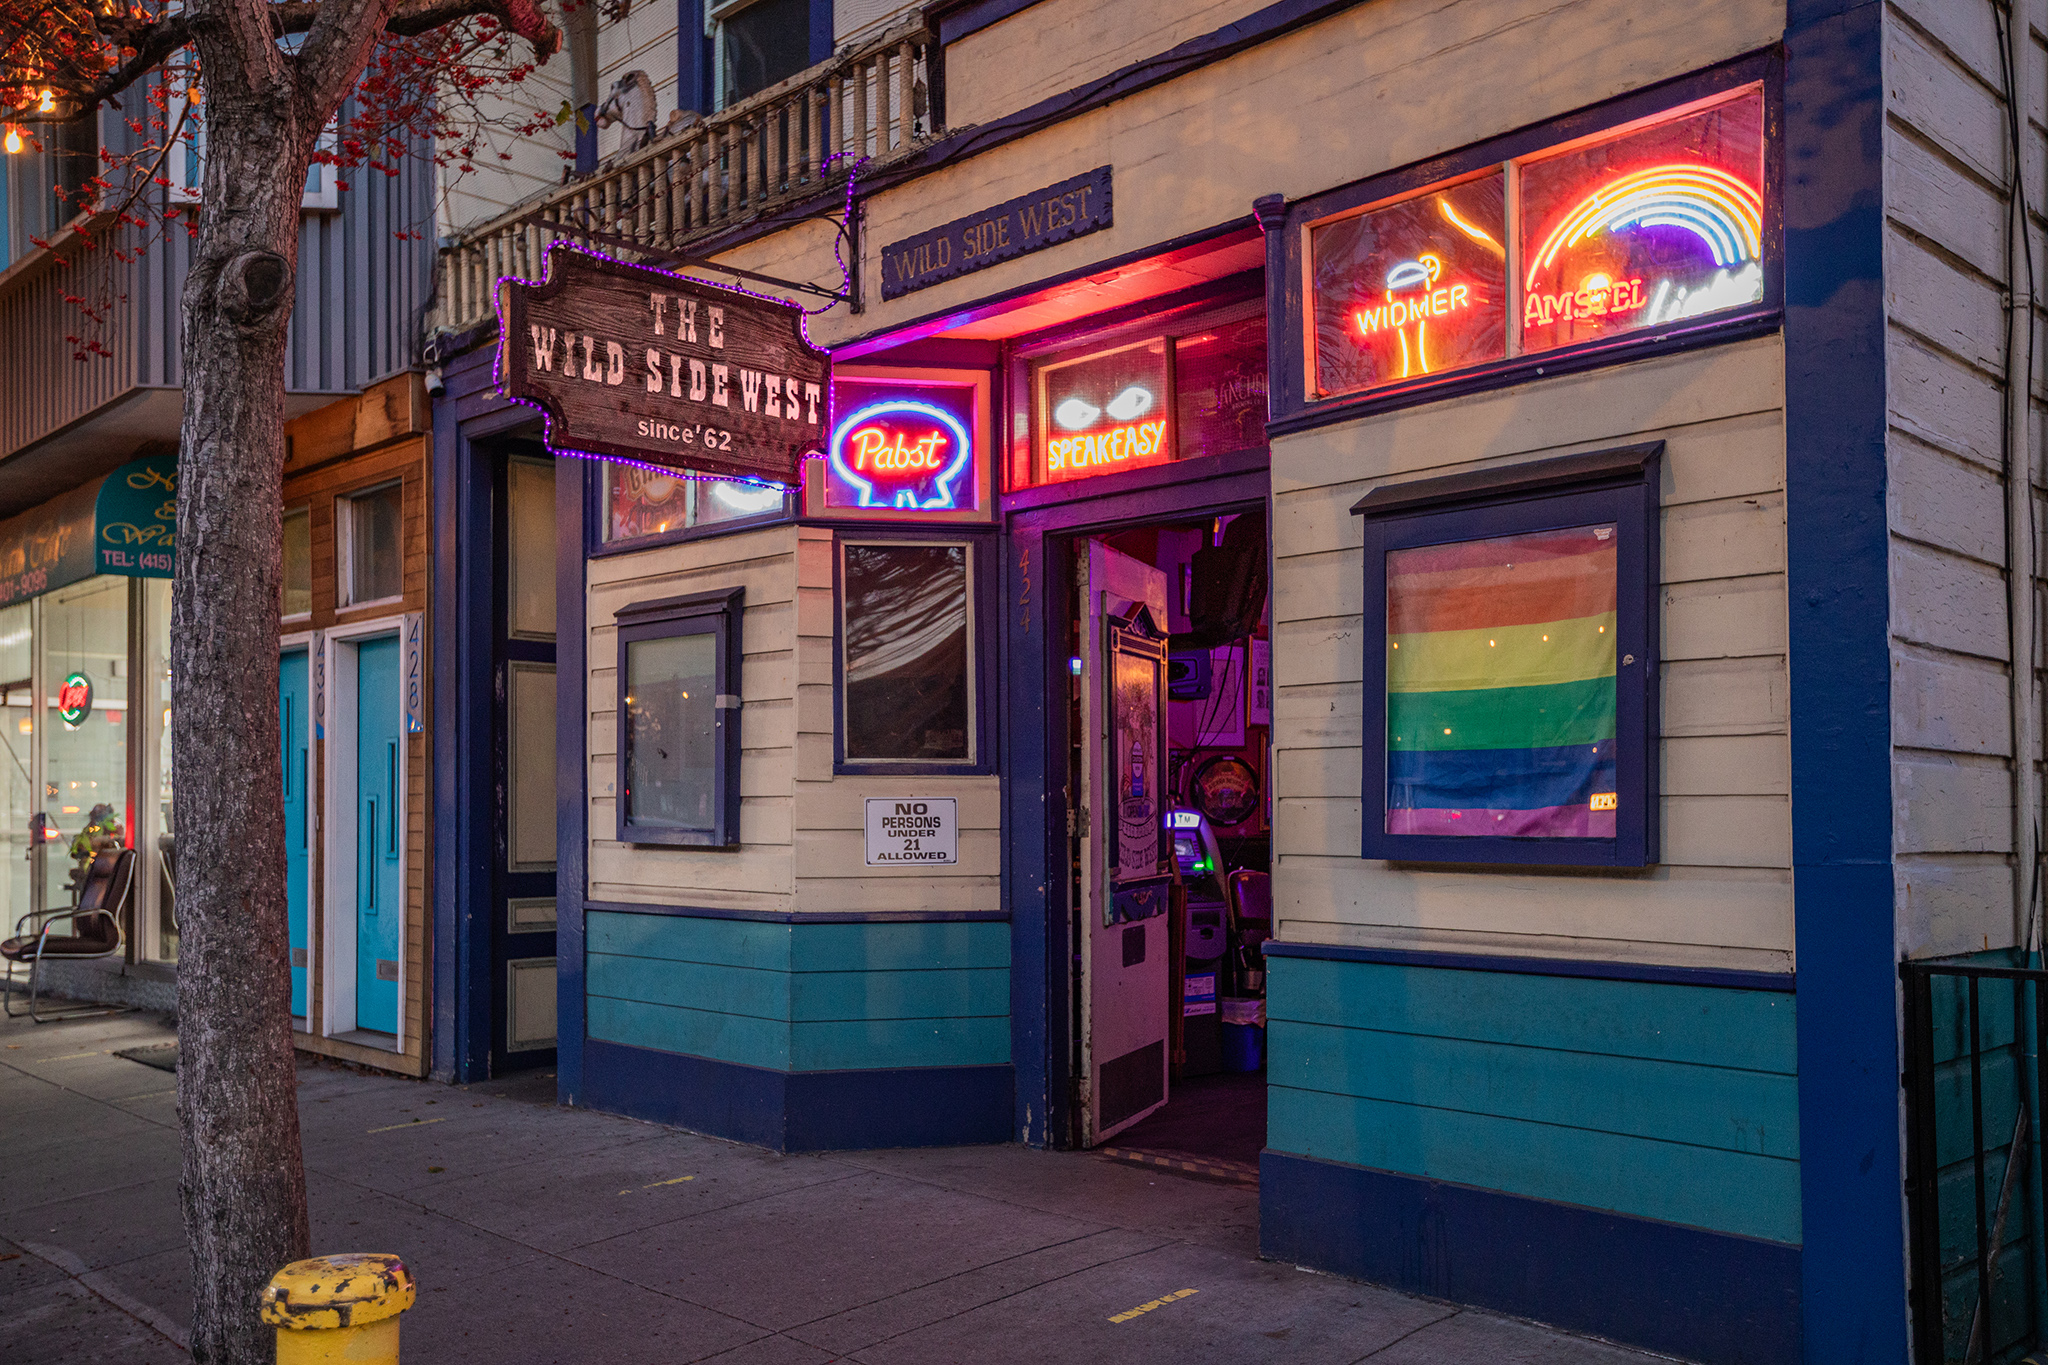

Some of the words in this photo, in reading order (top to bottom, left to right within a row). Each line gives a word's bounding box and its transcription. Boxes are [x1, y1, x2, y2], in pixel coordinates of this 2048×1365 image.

[893, 236, 951, 281] WILD
[962, 214, 1010, 260] SIDE
[1018, 184, 1092, 240] WEST
[650, 292, 724, 349] THE
[1356, 284, 1468, 335] WIDMER
[1523, 278, 1648, 328] AMSTEL
[531, 324, 624, 386] WILD
[646, 348, 729, 408] SIDE
[740, 369, 820, 425] WEST
[852, 427, 947, 470] Pabst
[1048, 420, 1166, 470] SPEAKEASY
[102, 549, 135, 567] TEL:
[139, 551, 172, 572] (415)
[1018, 549, 1031, 634] 424
[409, 619, 419, 710] 428
[882, 816, 941, 828] PERSONS
[888, 829, 936, 838] UNDER
[895, 803, 928, 815] NO
[877, 851, 947, 860] ALLOWED
[903, 838, 921, 851] 21
